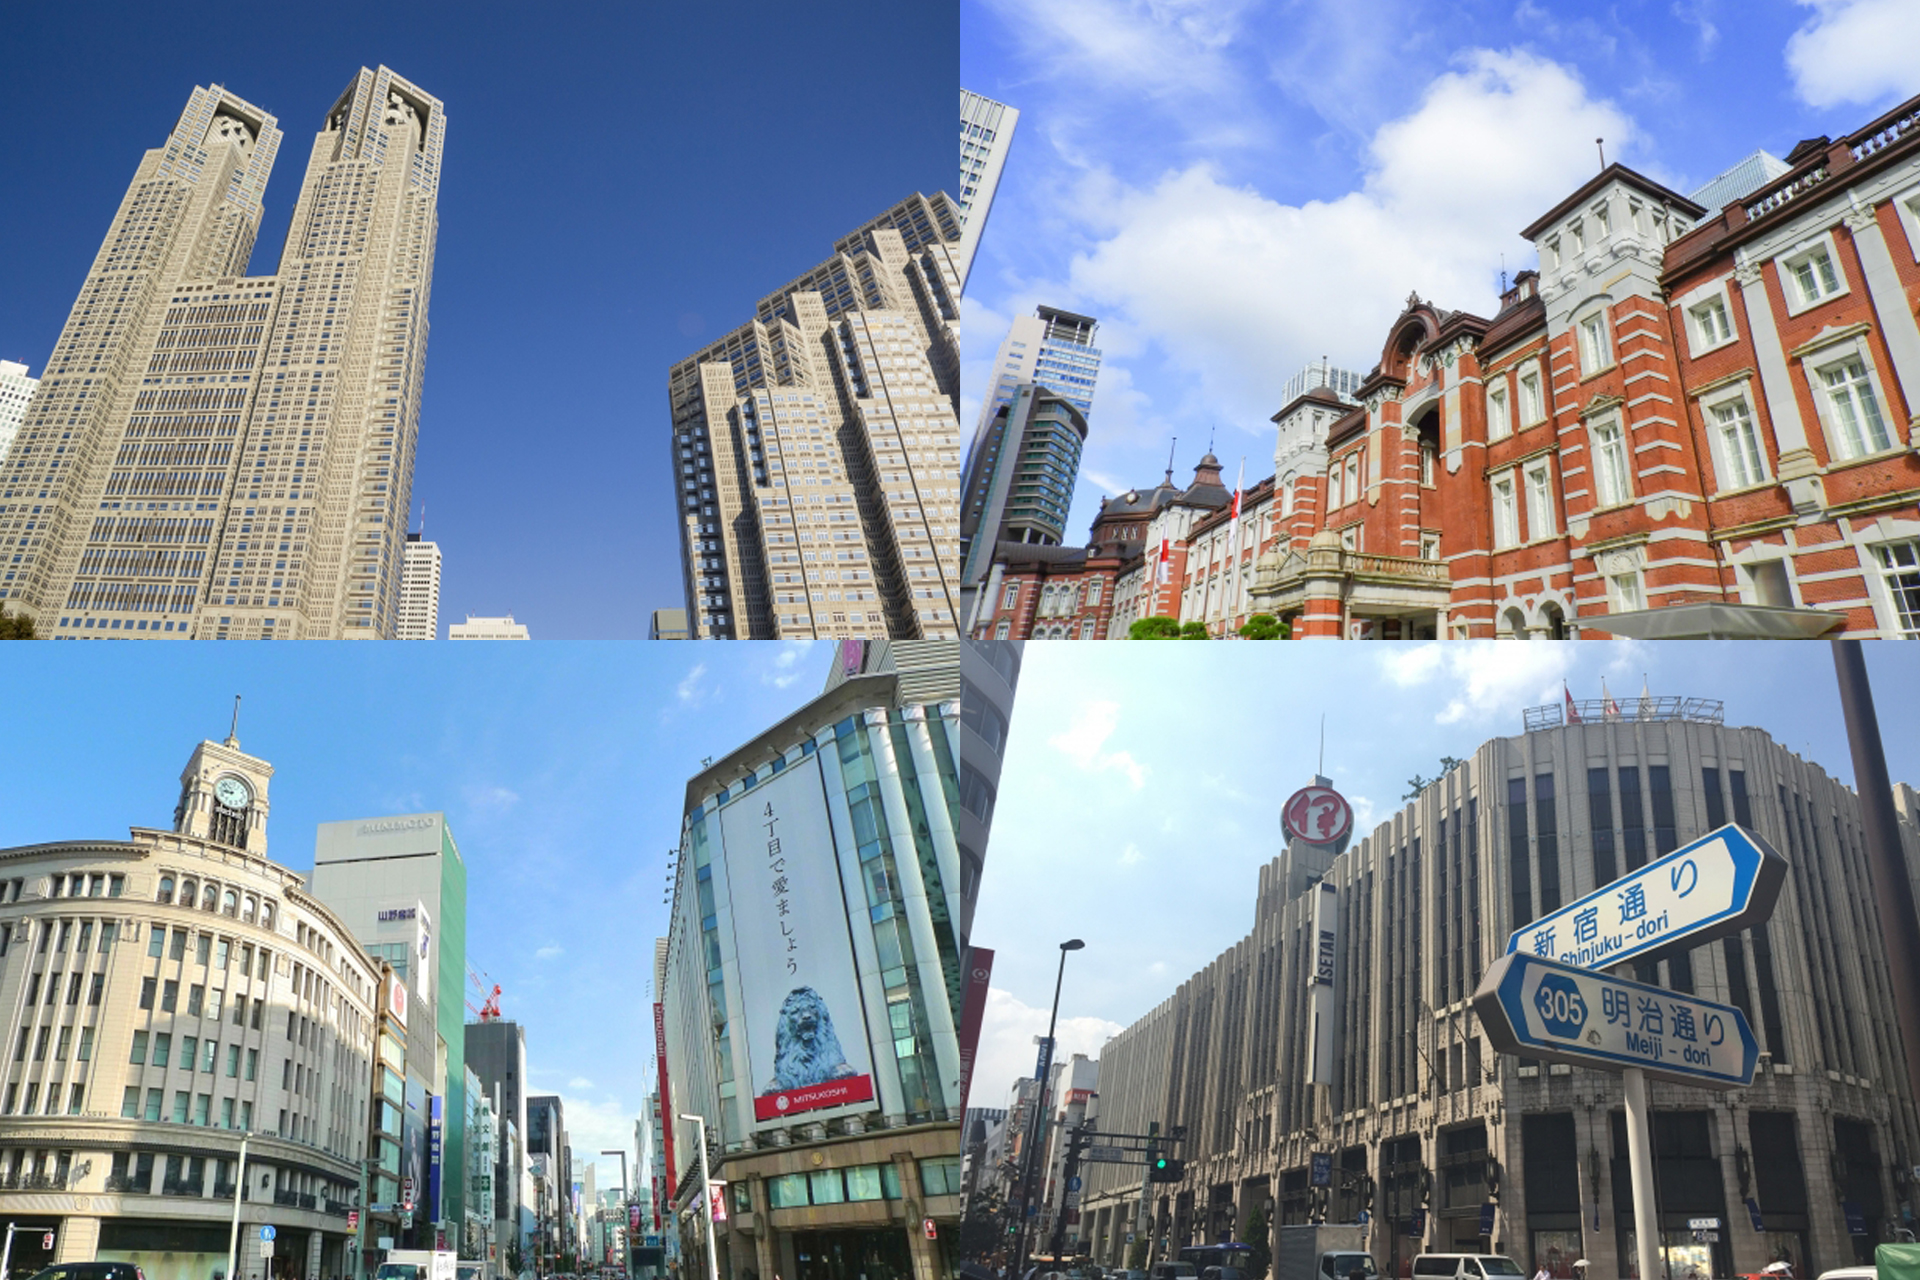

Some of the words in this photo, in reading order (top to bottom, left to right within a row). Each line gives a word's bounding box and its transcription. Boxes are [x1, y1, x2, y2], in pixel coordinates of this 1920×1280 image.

[1534, 859, 1698, 958] 新宿通り
[1317, 930, 1335, 988] ISETAN
[1540, 986, 1583, 1026] 305
[1602, 987, 1725, 1046] 明治通り
[793, 1087, 848, 1104] MITSUKOSHI
